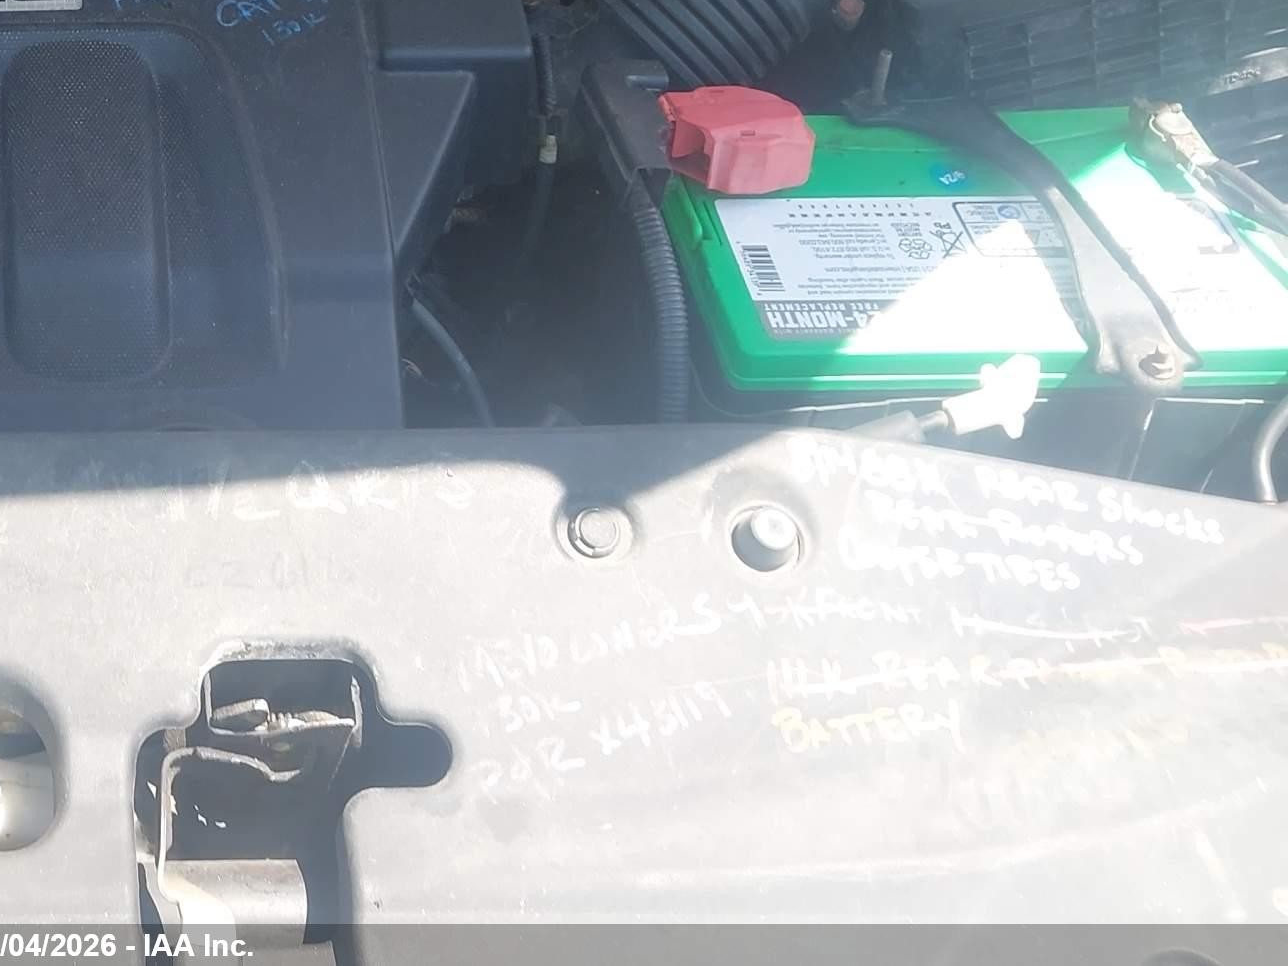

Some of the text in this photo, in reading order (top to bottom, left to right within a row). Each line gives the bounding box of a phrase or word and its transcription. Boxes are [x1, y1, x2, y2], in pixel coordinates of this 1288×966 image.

[764, 302, 846, 311] REPLACEMENT
[766, 310, 878, 329] 4-MONTH
[770, 697, 967, 756] BATTERY
